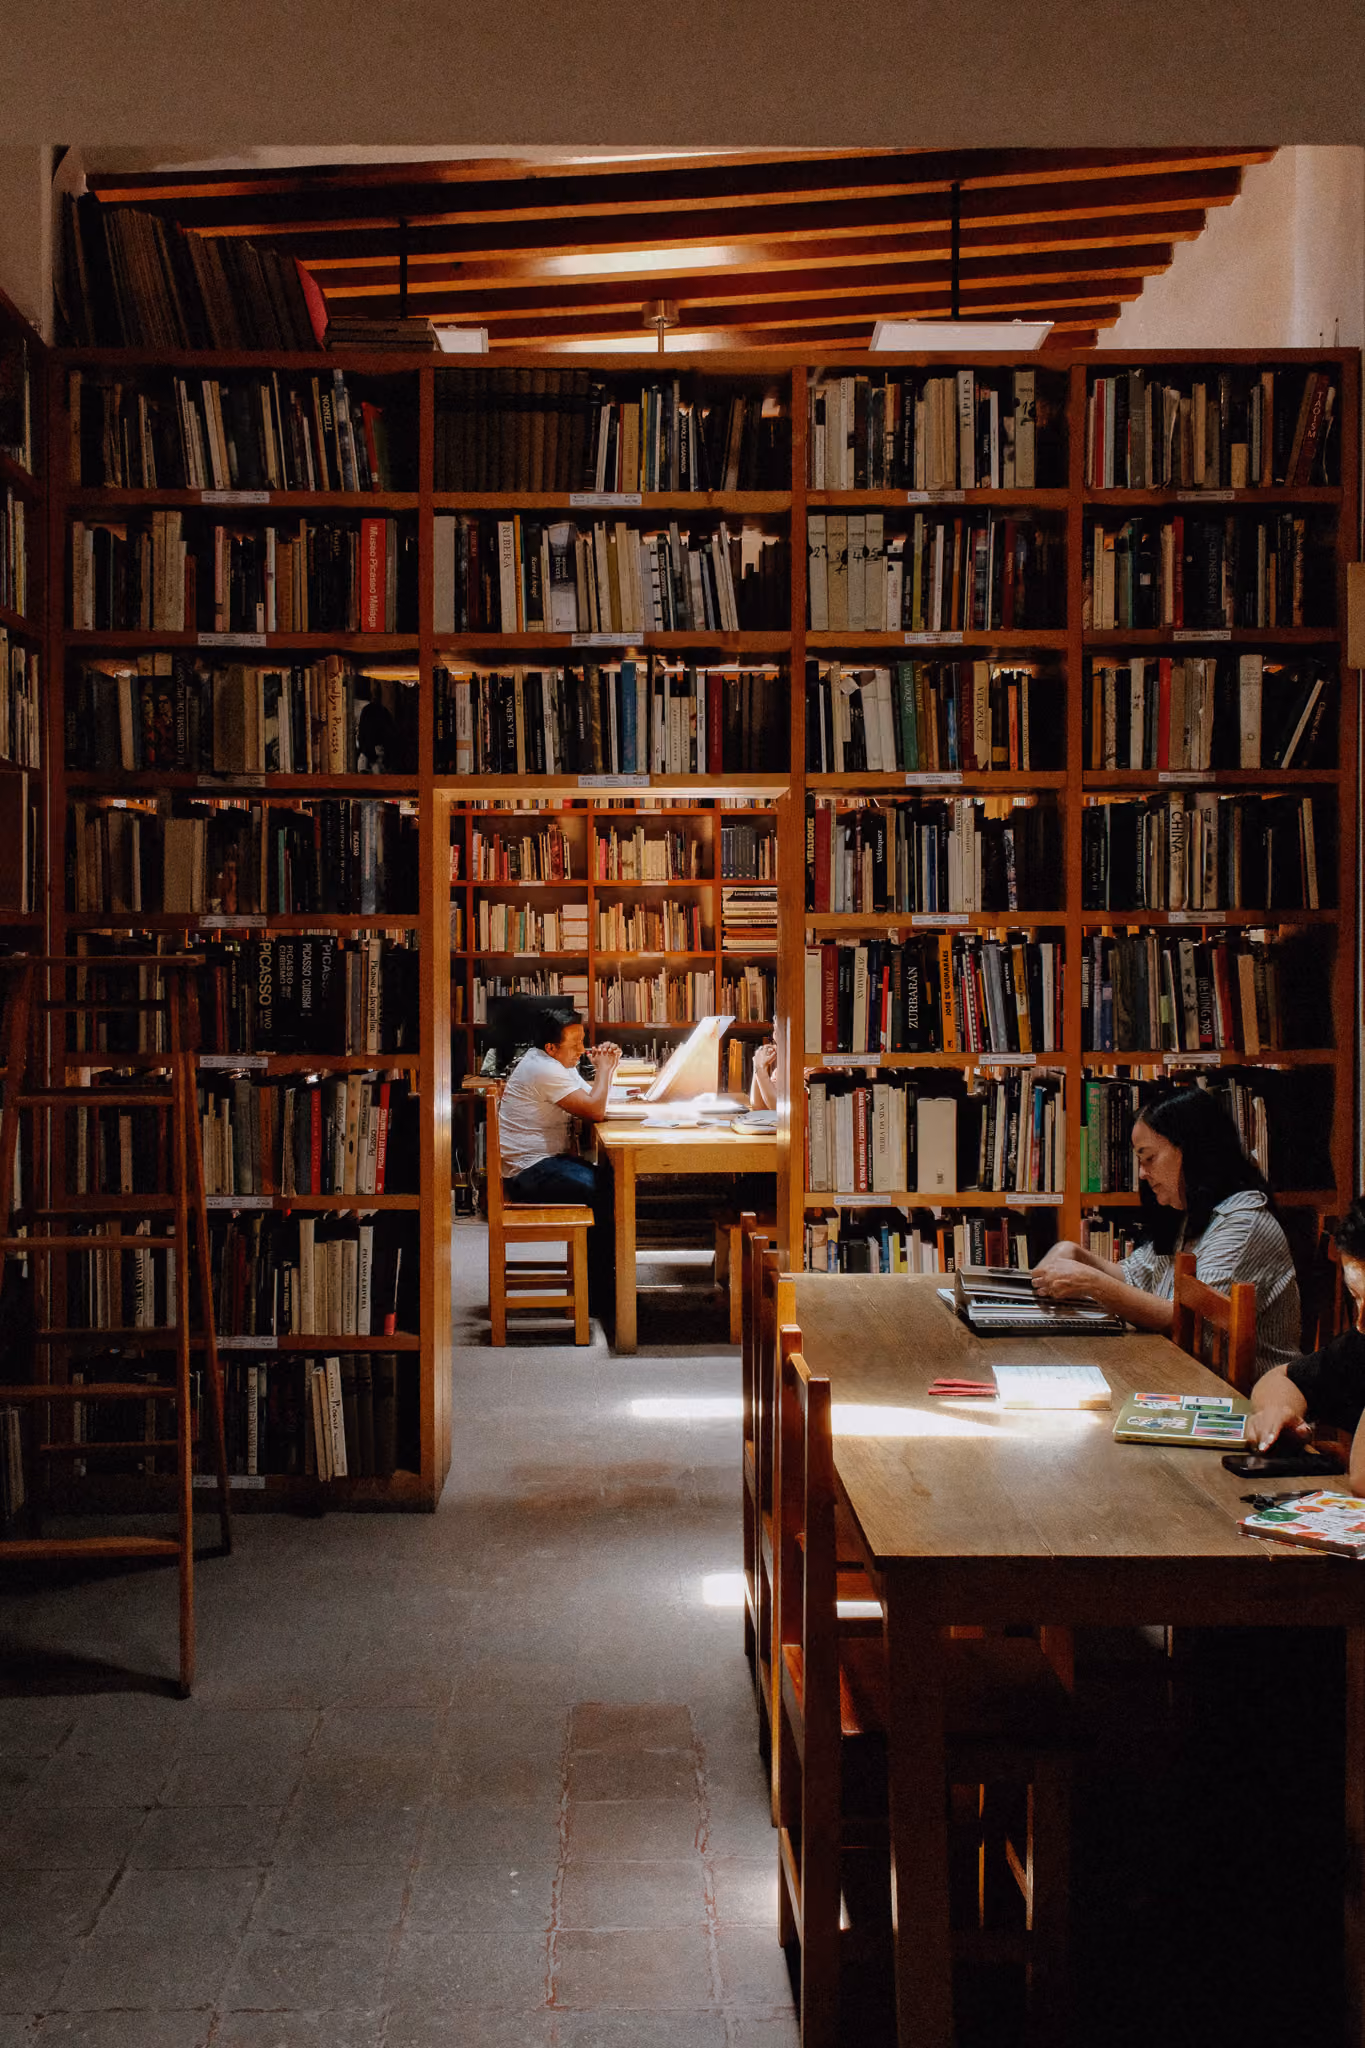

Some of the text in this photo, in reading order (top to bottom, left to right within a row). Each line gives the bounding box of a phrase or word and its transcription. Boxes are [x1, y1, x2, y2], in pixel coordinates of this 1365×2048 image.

[1307, 391, 1325, 439] TAOISM
[369, 526, 378, 557] Museo
[502, 526, 512, 568] RIBERA
[369, 558, 378, 594] Picasso
[503, 695, 515, 748] DE LA SERNA
[975, 686, 985, 741] VELAZQUEZ
[330, 717, 342, 754] Picasso
[1171, 811, 1185, 854] CHINA
[279, 944, 287, 985] CUBISMO
[286, 944, 294, 985] PICASSO
[302, 943, 313, 1009] PICASSO CUBISM
[258, 942, 273, 1030] PICASSO VIVO
[367, 959, 380, 1034] Picasso Jacqueline
[904, 965, 919, 1030] ZURBARÁN
[945, 991, 951, 1000] DE
[368, 1129, 378, 1158] Picasso
[377, 1147, 386, 1169] PICASSO
[974, 1221, 983, 1265] Konrad Witz
